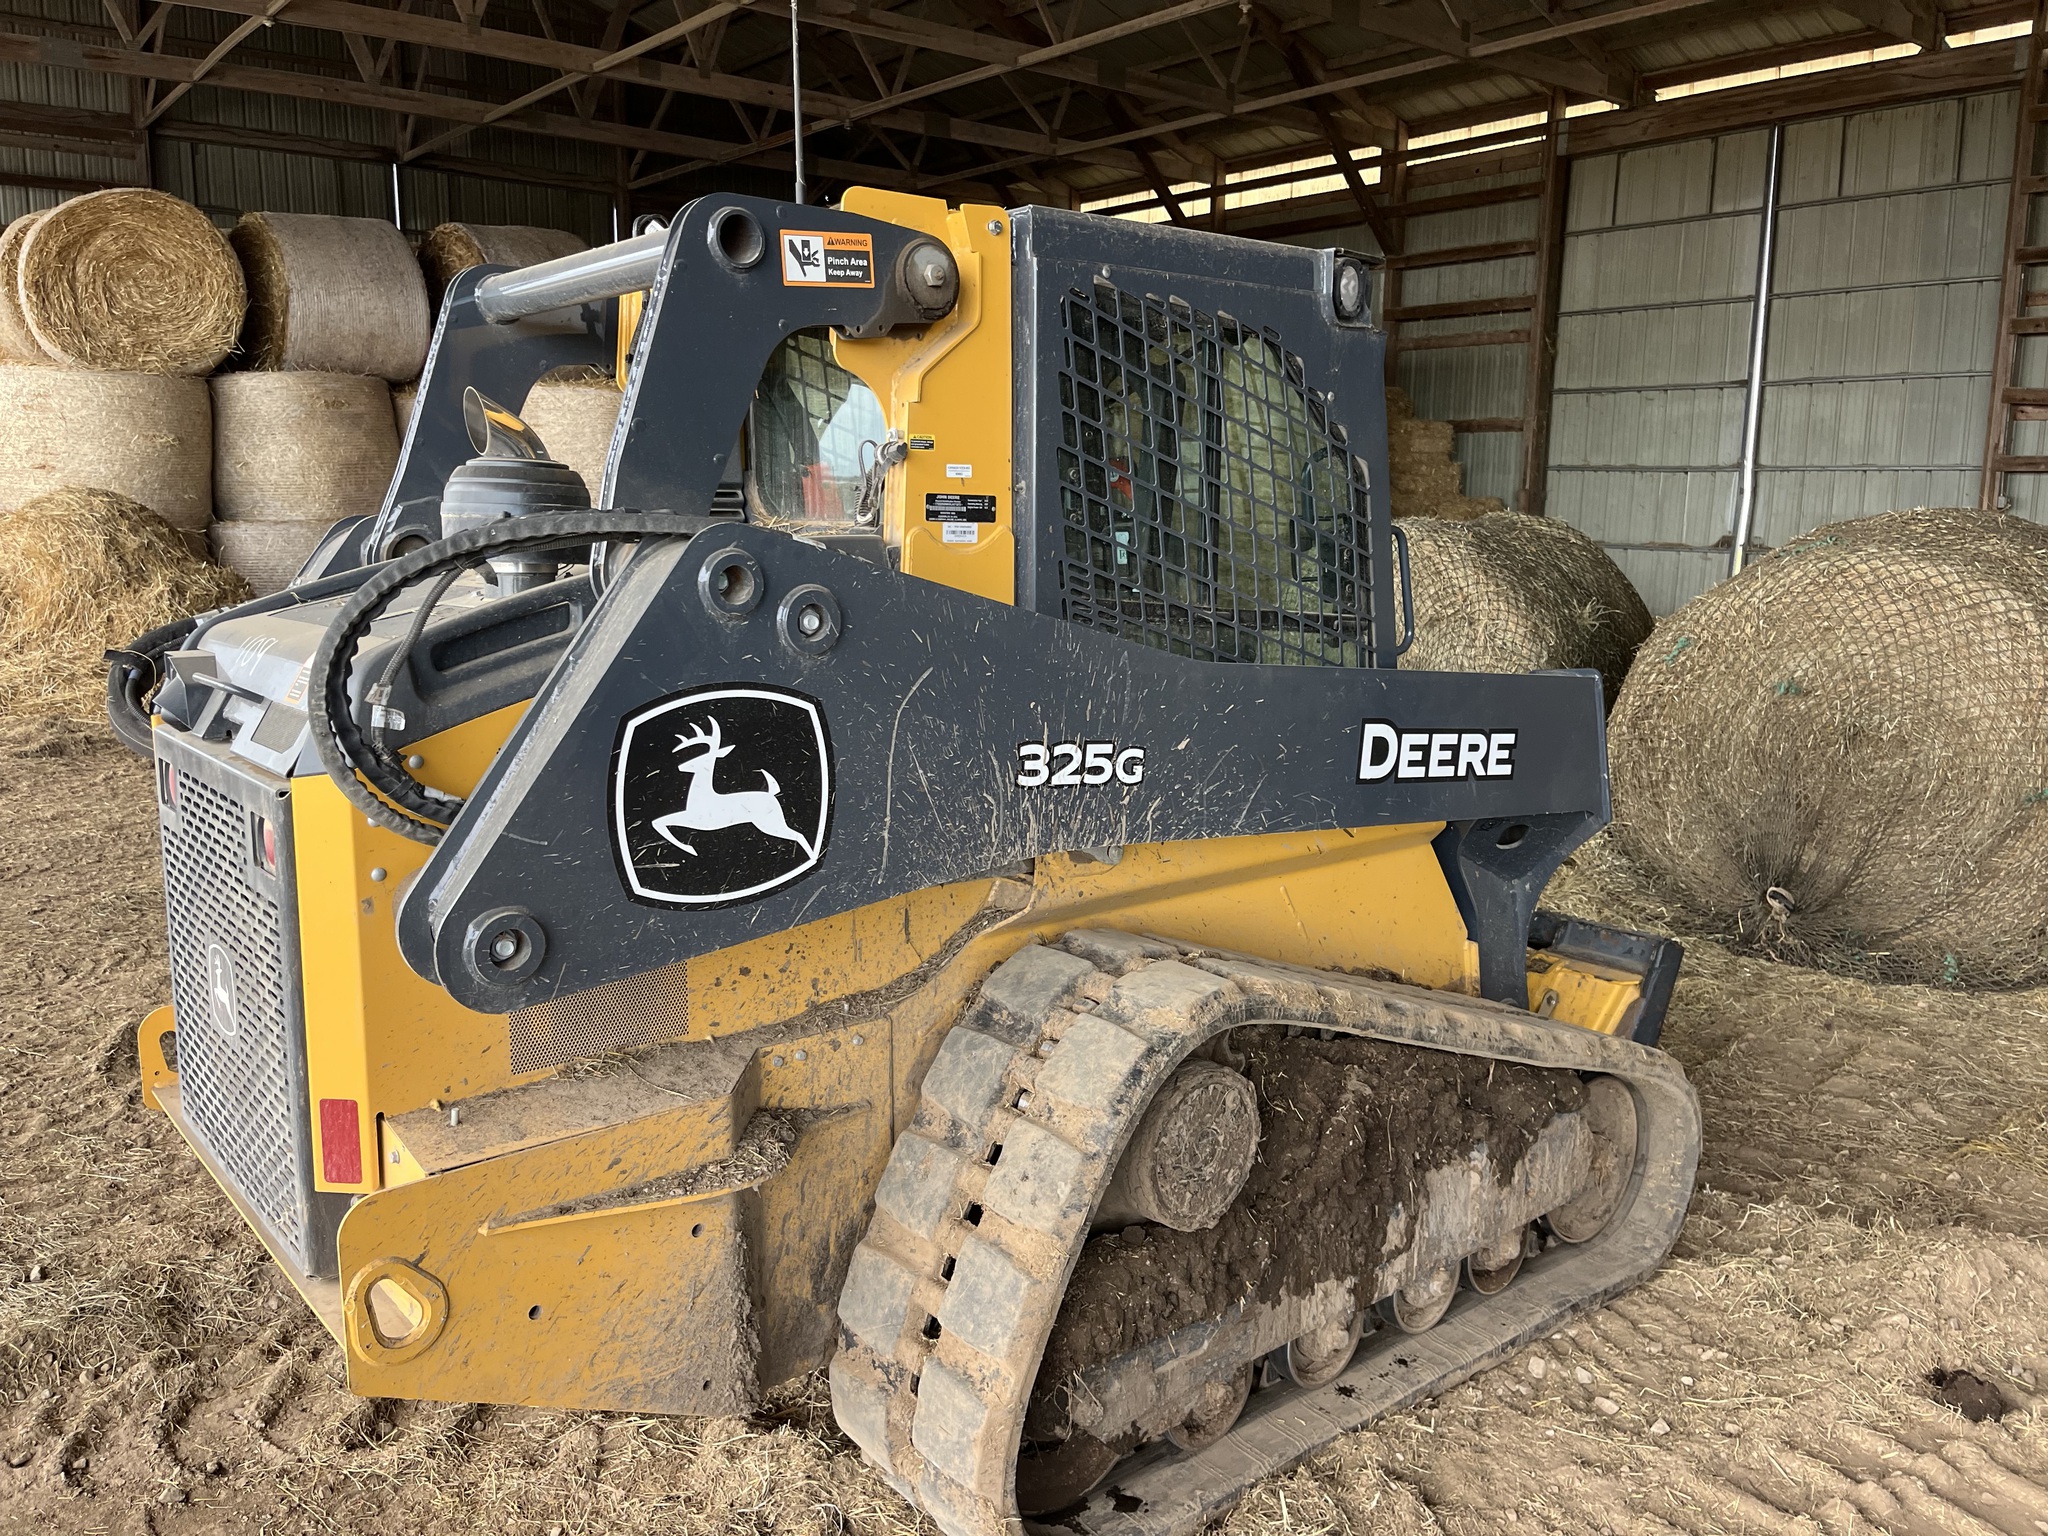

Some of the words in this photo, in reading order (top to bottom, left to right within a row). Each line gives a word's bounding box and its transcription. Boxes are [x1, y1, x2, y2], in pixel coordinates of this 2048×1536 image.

[834, 238, 868, 246] WARNING
[827, 256, 849, 265] Pinch
[850, 257, 868, 266] Area
[828, 268, 845, 277] Keep
[845, 269, 863, 278] Away
[1360, 723, 1516, 779] DEERE
[1017, 743, 1144, 786] 325G
